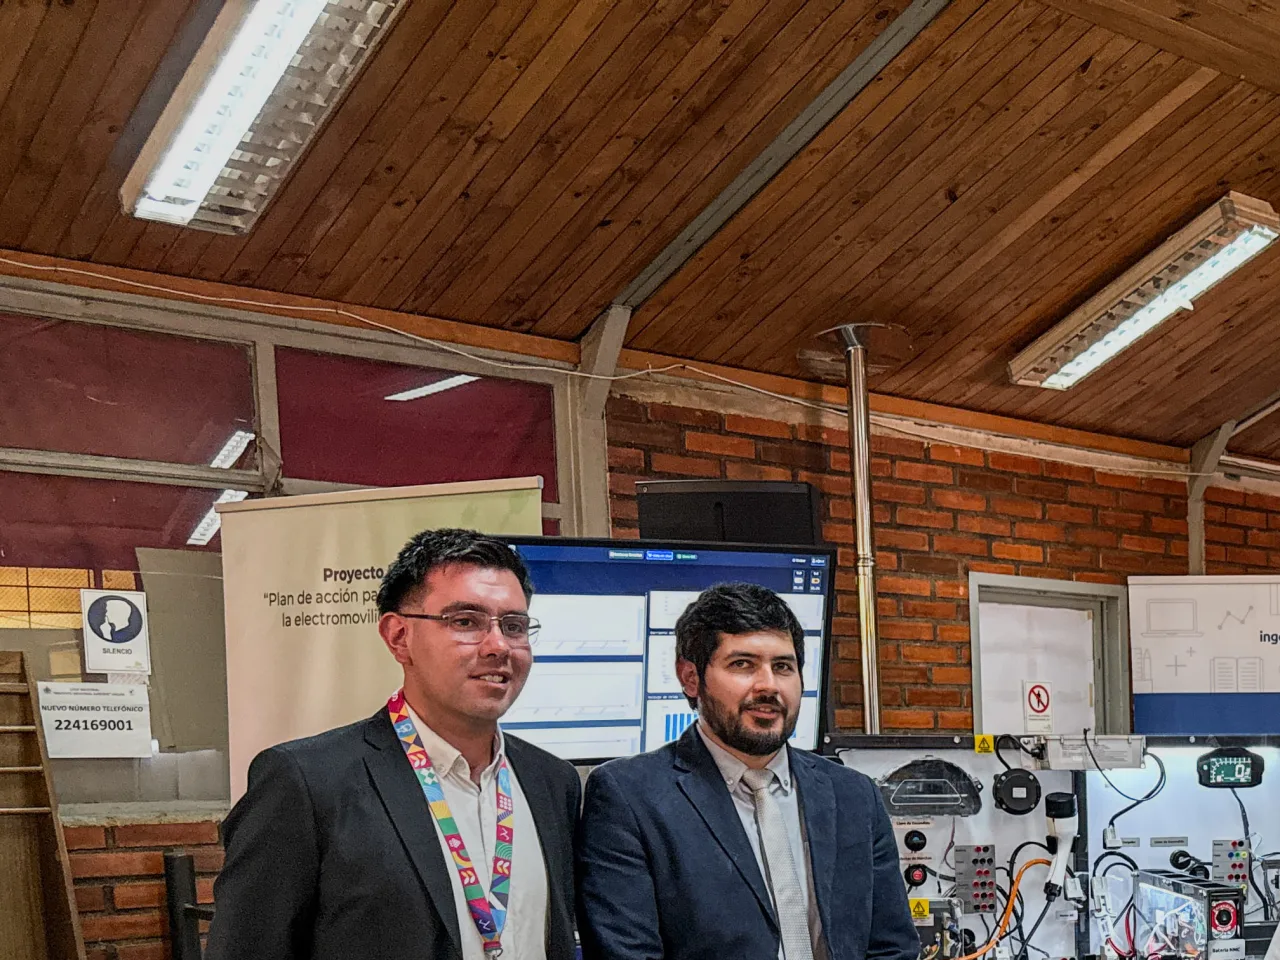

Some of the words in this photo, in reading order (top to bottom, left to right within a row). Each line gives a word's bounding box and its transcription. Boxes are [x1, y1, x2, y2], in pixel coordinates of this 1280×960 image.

[323, 566, 384, 584] Proyecto
[297, 590, 312, 604] de
[315, 588, 358, 603] acción
[362, 590, 378, 605] pa
[282, 613, 292, 627] la
[294, 608, 380, 626] electromovili
[102, 647, 133, 655] SILENCIO
[69, 703, 101, 712] NÚMERO
[103, 704, 144, 713] TELEFÓNICO
[54, 719, 134, 731] 224169001
